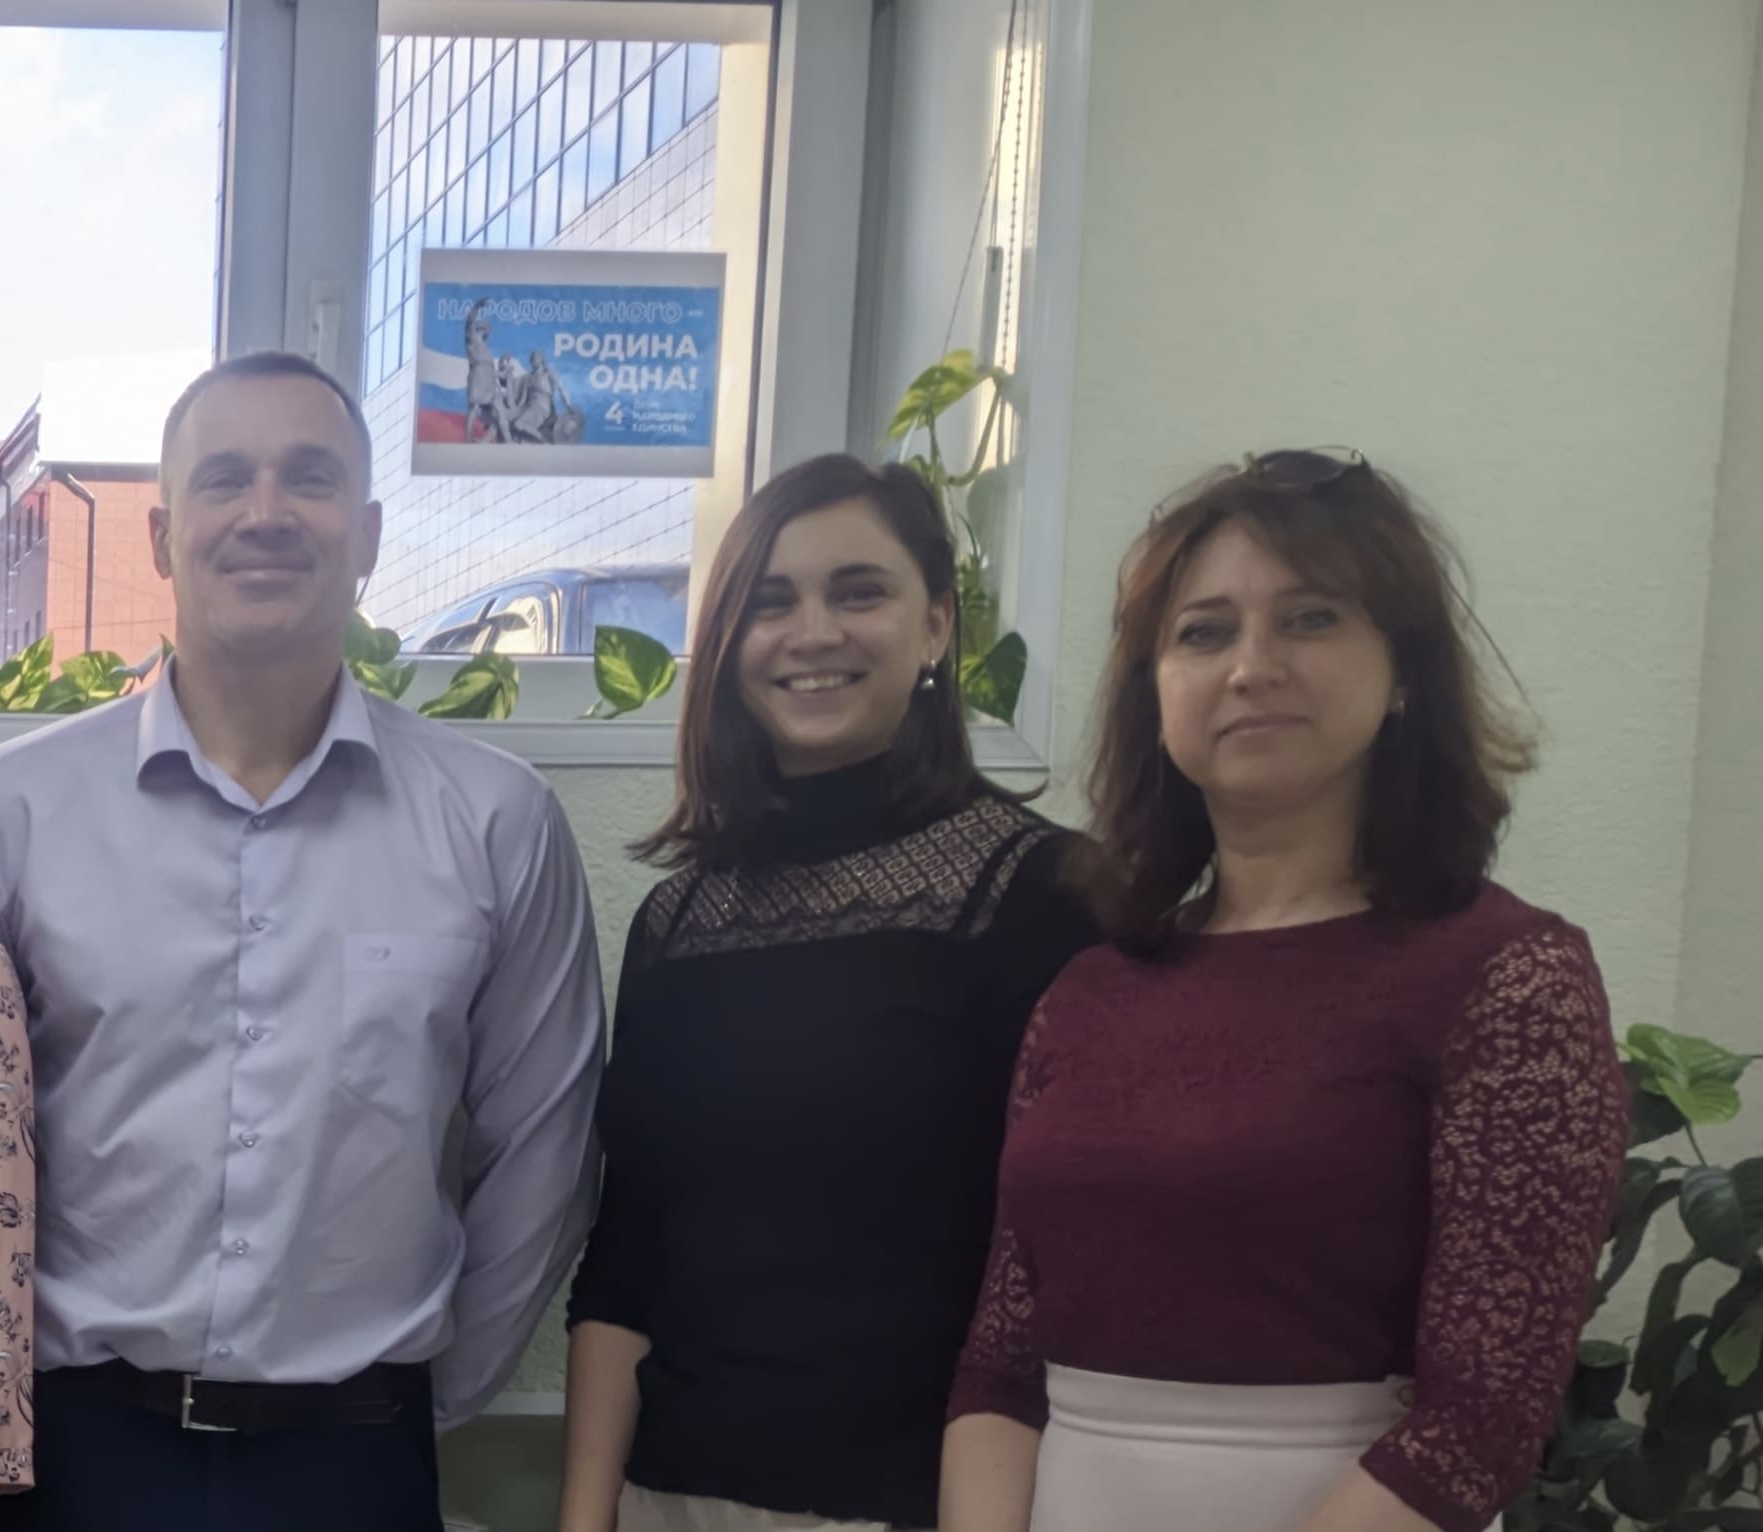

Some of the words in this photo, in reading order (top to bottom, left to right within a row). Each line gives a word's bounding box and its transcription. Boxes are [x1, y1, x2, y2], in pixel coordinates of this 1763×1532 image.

[582, 302, 682, 324] МНОГО
[553, 333, 698, 361] РОДИНА
[589, 364, 698, 393] ОДНА!
[604, 400, 625, 425] 4
